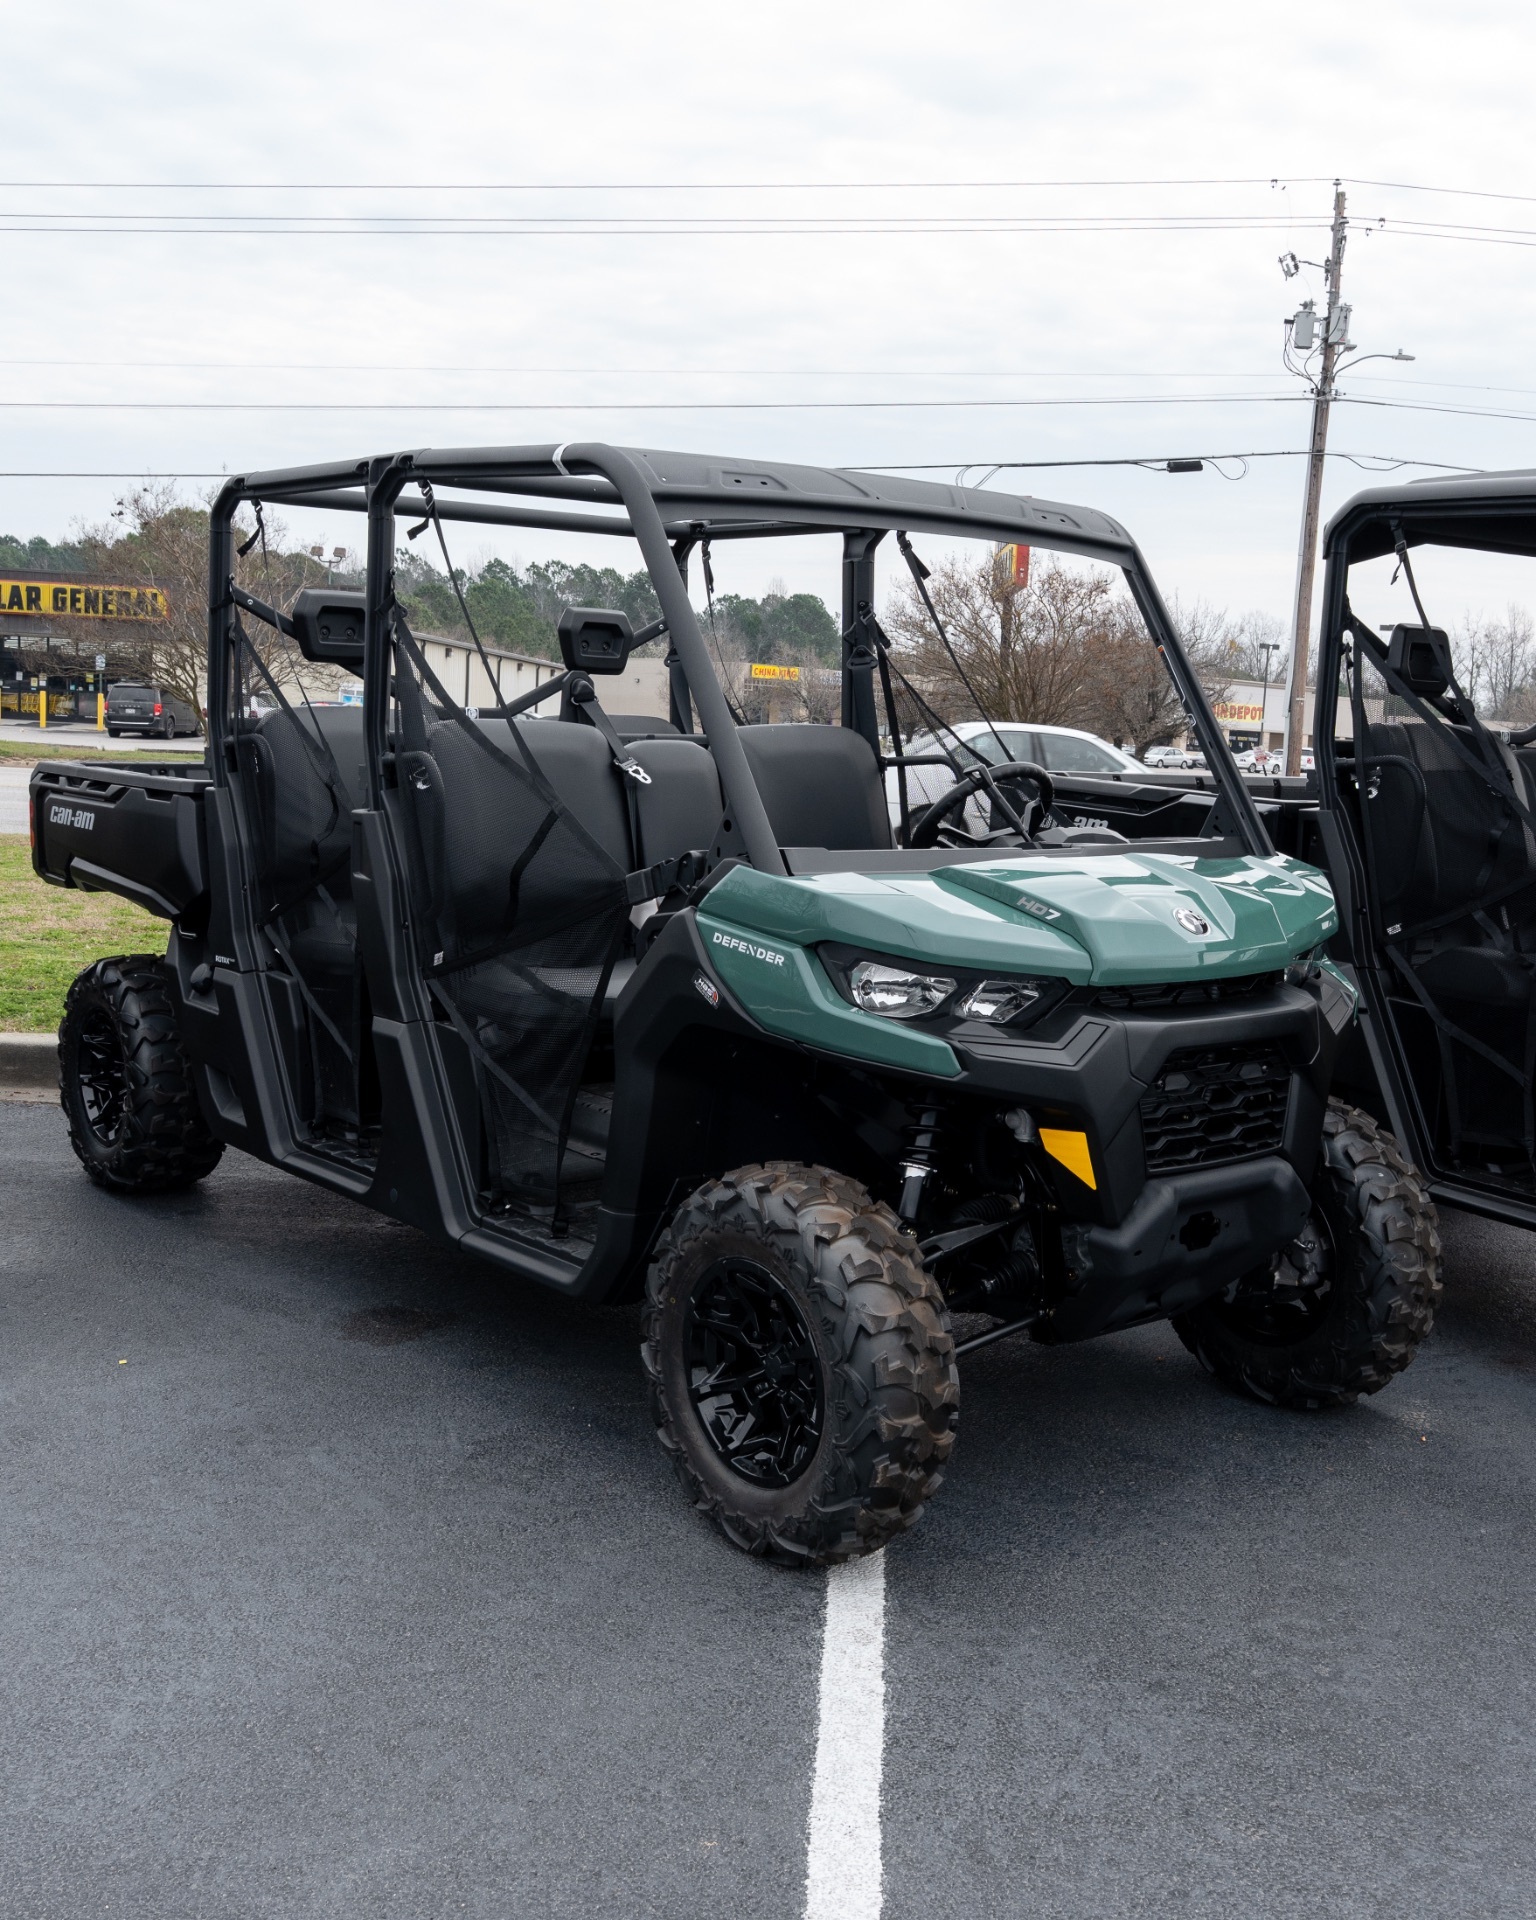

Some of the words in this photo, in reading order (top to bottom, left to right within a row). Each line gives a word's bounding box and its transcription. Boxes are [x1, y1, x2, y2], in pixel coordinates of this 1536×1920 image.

[53, 586, 159, 617] GENERAL
[754, 667, 776, 676] CHINA
[1229, 705, 1263, 720] DEPOT
[1016, 896, 1062, 920] HD7
[712, 931, 785, 967] DEFENDER
